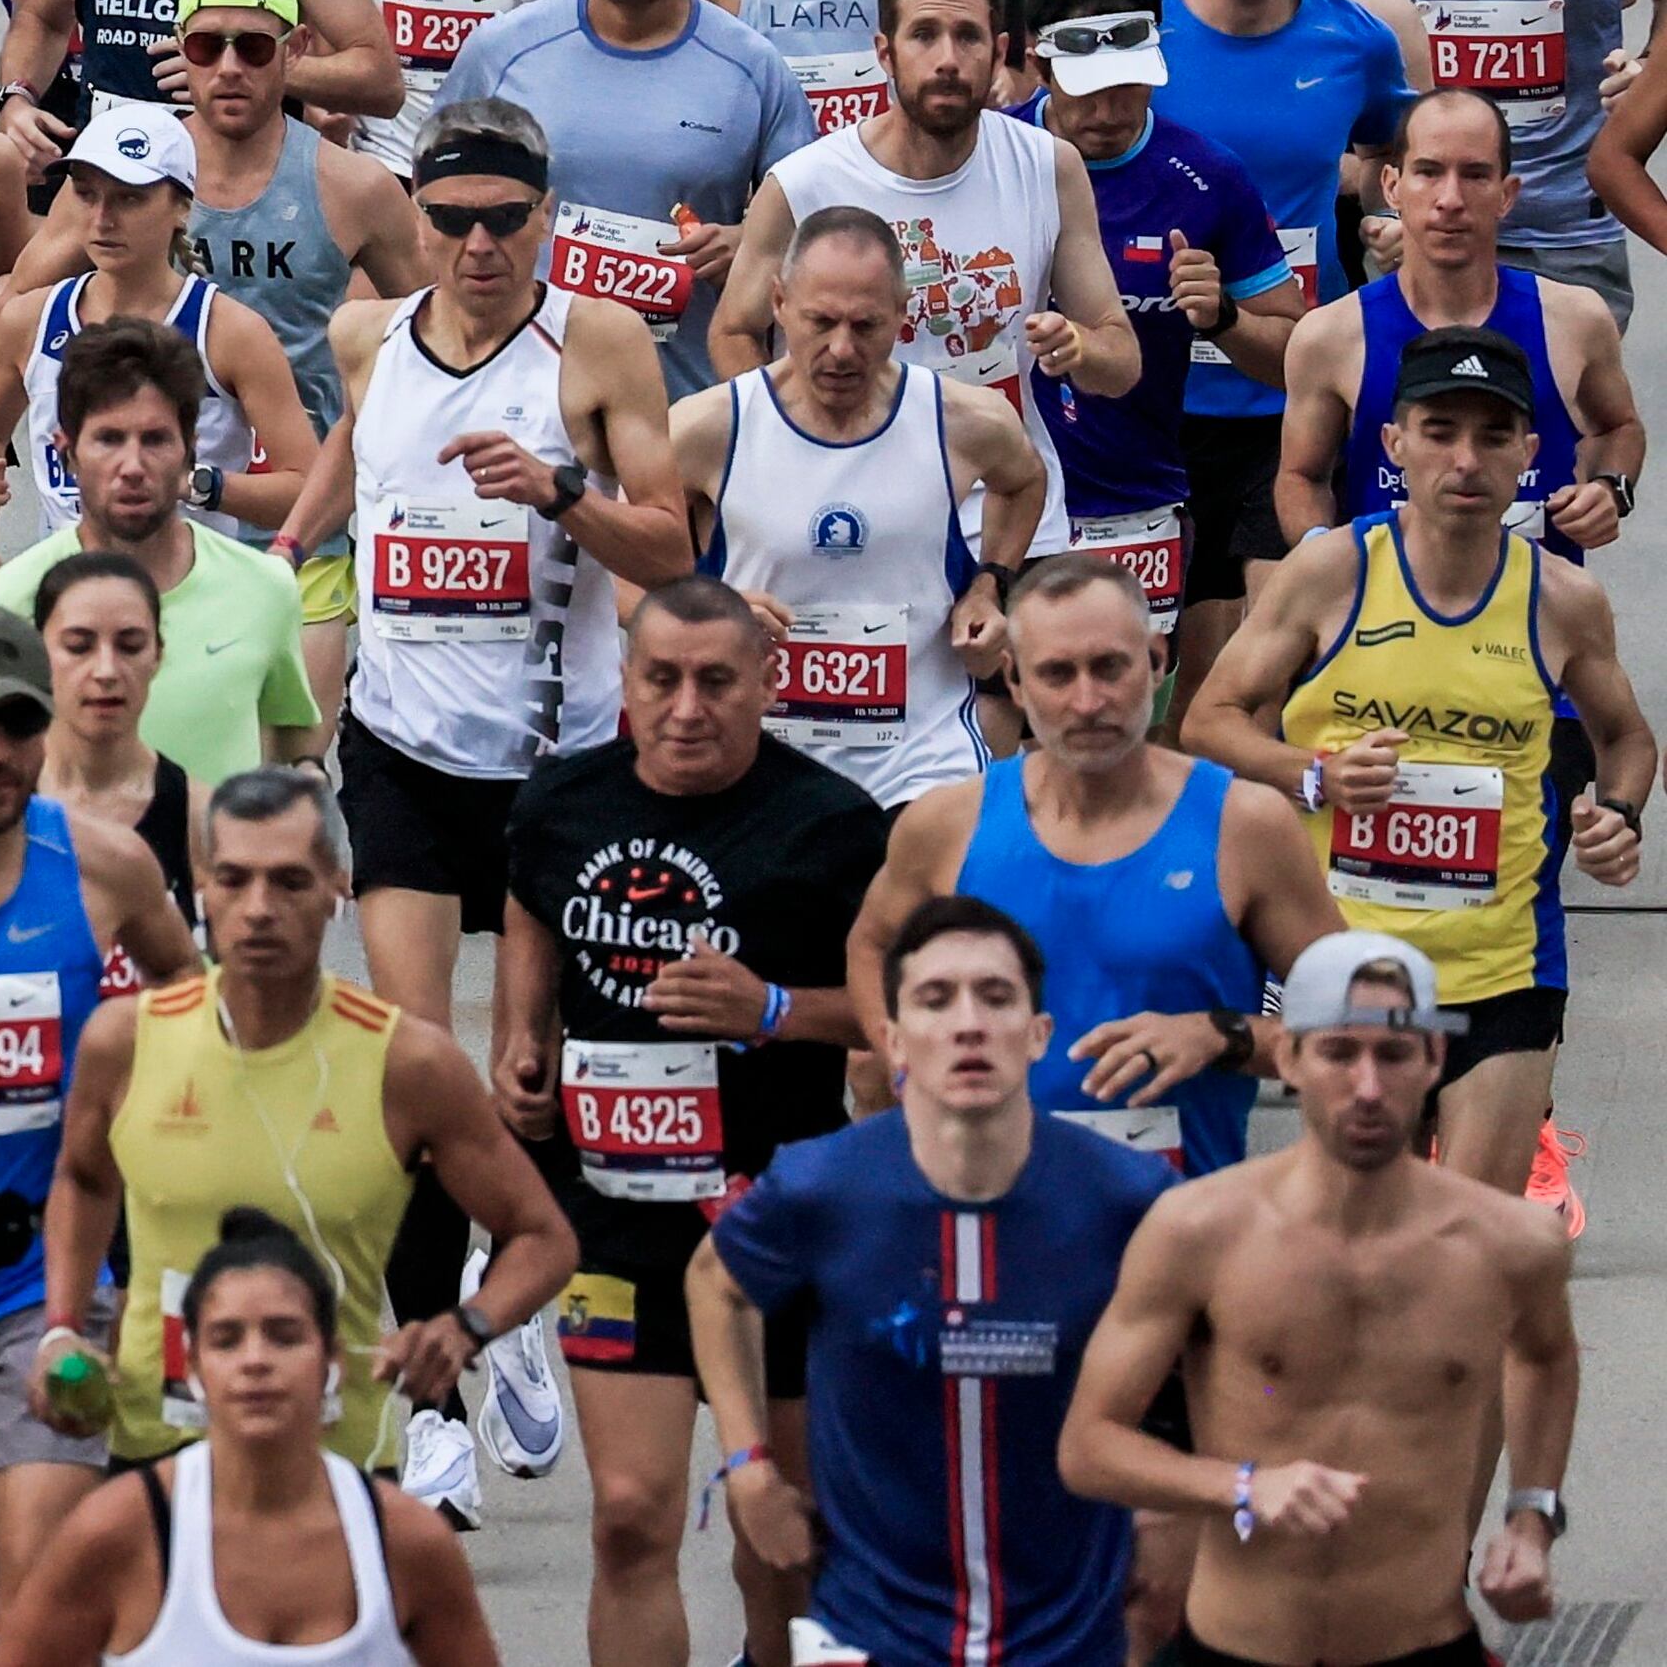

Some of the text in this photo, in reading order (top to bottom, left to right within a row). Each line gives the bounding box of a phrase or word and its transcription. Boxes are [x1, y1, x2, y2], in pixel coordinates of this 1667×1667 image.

[97, 29, 136, 46] ROAD
[395, 9, 413, 46] B
[770, 1, 869, 29] LARA
[1438, 41, 1544, 79] B 7211
[564, 251, 677, 305] B 5222
[389, 544, 511, 590] B 9237
[1112, 549, 1168, 591] 328
[802, 651, 887, 695] 6321
[1334, 691, 1536, 745] SAVAZONI
[1352, 812, 1477, 860] B 6381
[577, 843, 623, 890] BANK
[629, 838, 655, 860] OF
[564, 895, 739, 960] Chicago
[579, 1095, 702, 1147] B 4325
